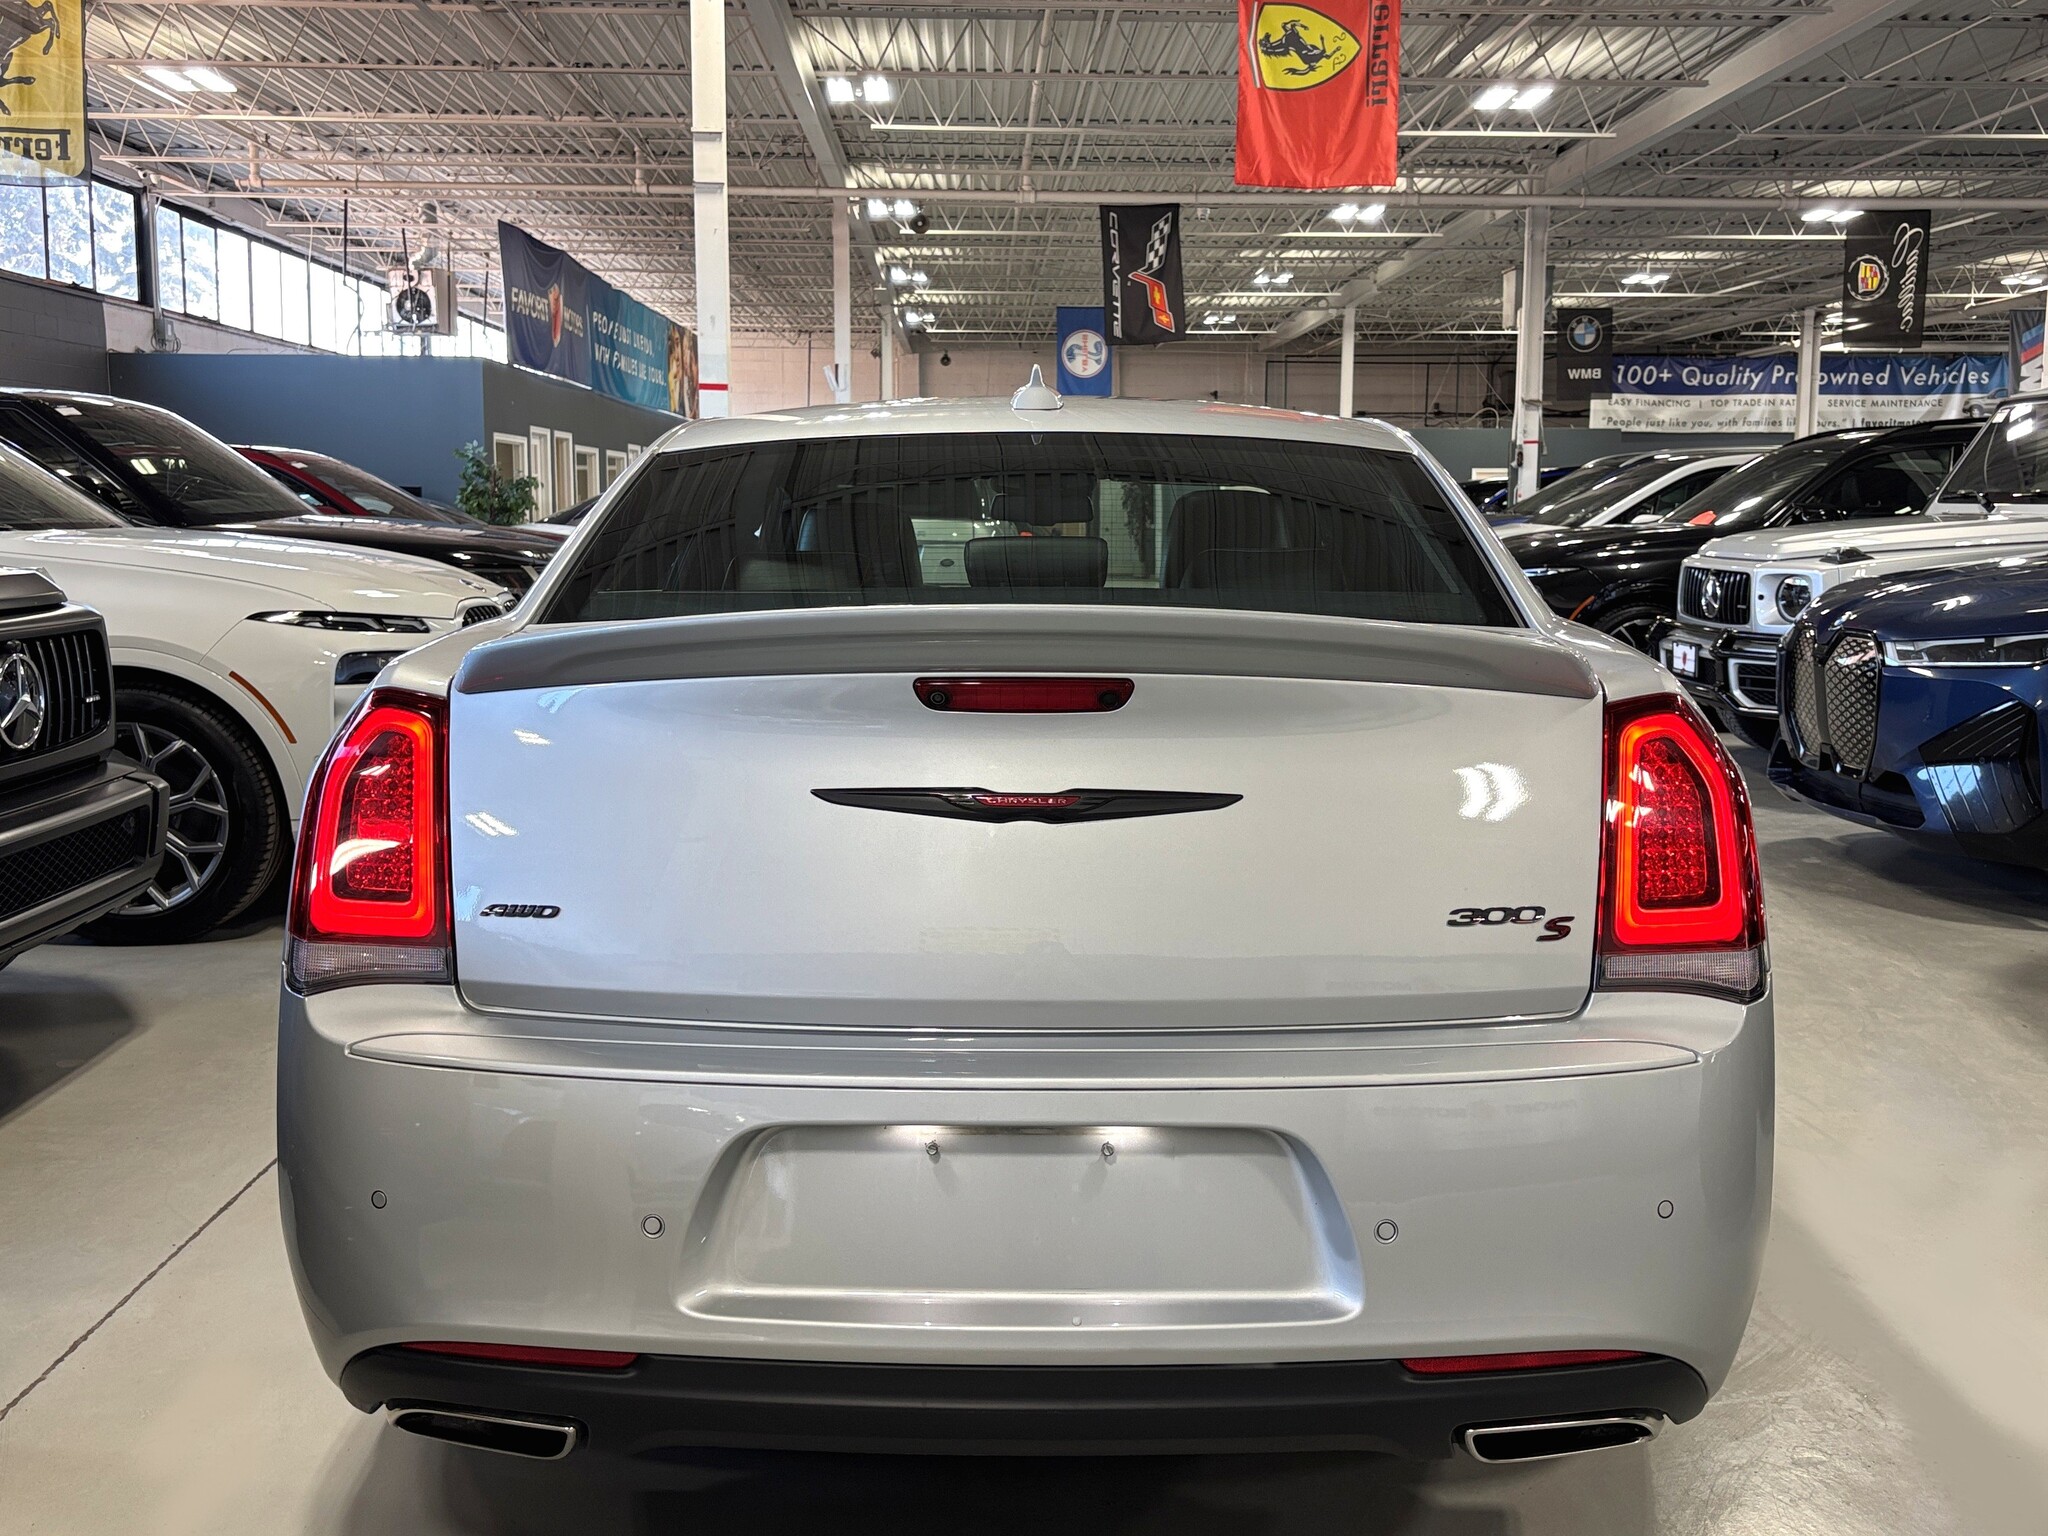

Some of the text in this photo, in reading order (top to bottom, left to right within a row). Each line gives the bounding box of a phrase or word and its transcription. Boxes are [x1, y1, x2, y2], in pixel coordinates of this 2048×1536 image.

[1109, 211, 1123, 339] CORVETTE
[1617, 363, 1990, 391] 100+ Quality Prowned Vehicles
[1608, 398, 1632, 407] EASY
[1635, 398, 1692, 408] FINANCING
[1710, 399, 1730, 408] TOP
[1779, 398, 1796, 407] RAT
[1827, 398, 1867, 408] SERVICE
[1870, 398, 1944, 408] MAINTENANCE
[1645, 418, 1666, 429] just
[1668, 417, 1688, 427] like
[1717, 417, 1742, 427] with
[1742, 417, 1783, 427] families
[986, 796, 1067, 804] CHRYSLER
[479, 903, 562, 919] AWD
[1447, 905, 1546, 926] 300
